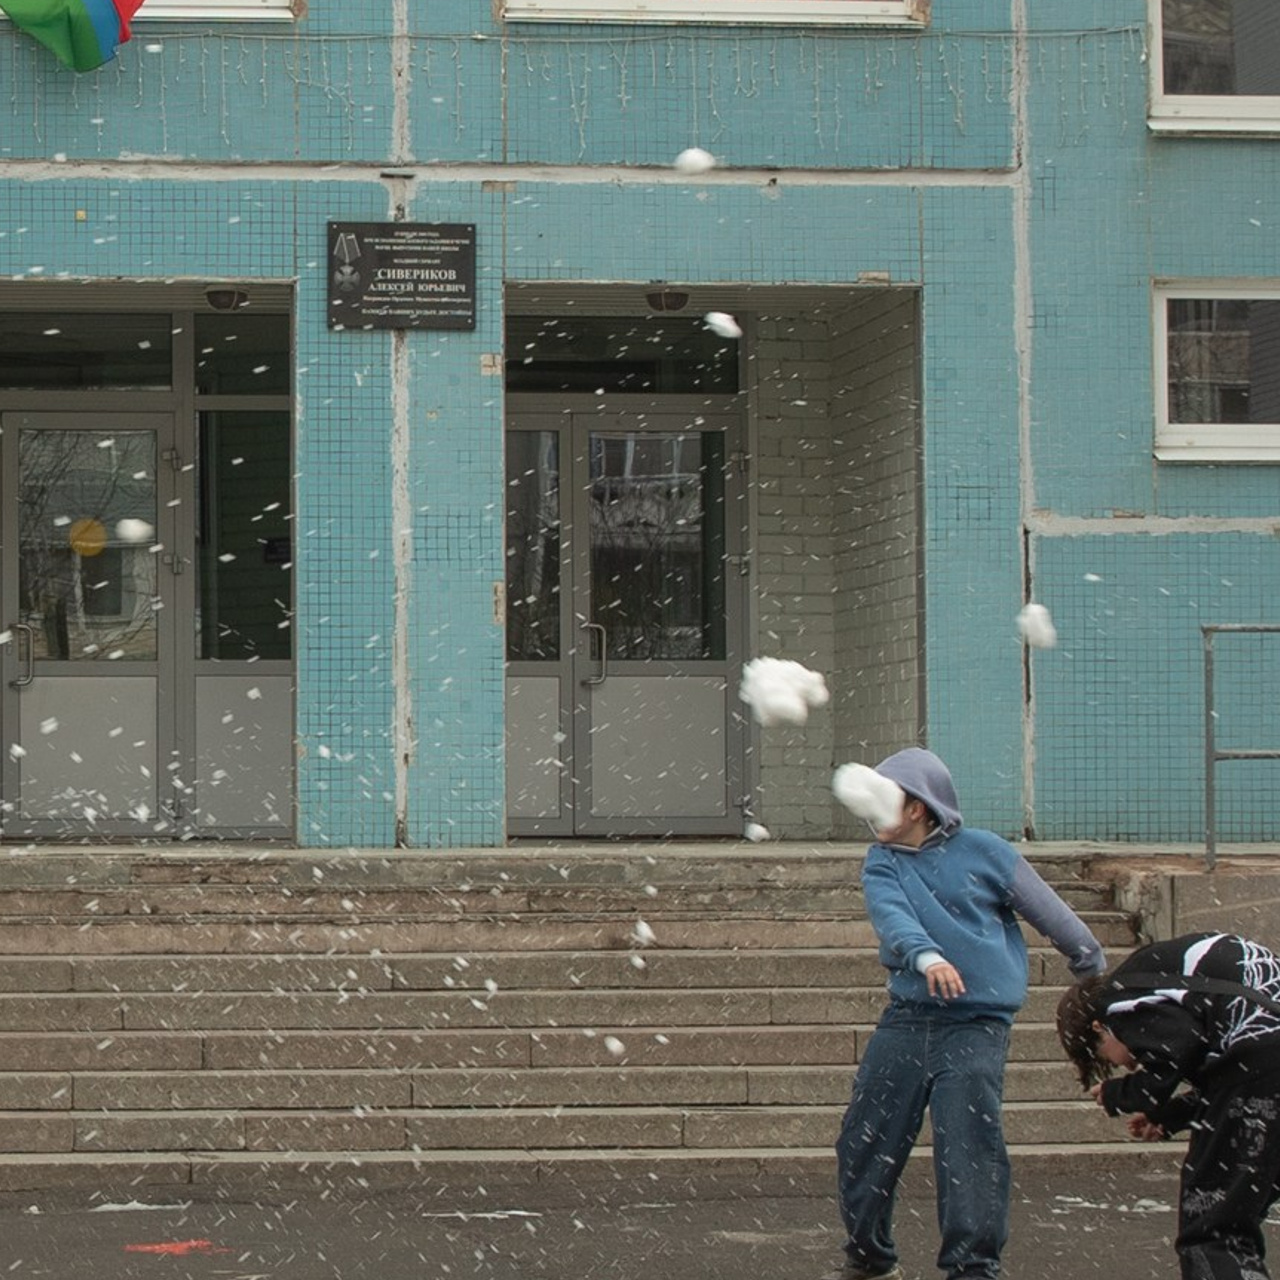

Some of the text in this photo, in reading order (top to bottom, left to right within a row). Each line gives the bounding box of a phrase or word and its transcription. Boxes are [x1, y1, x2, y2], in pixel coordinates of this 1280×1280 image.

[377, 268, 457, 280] СИВЕРИКОВ
[368, 282, 466, 293] АЛЕКСЕЙ ЮРЬЕВИЧ
